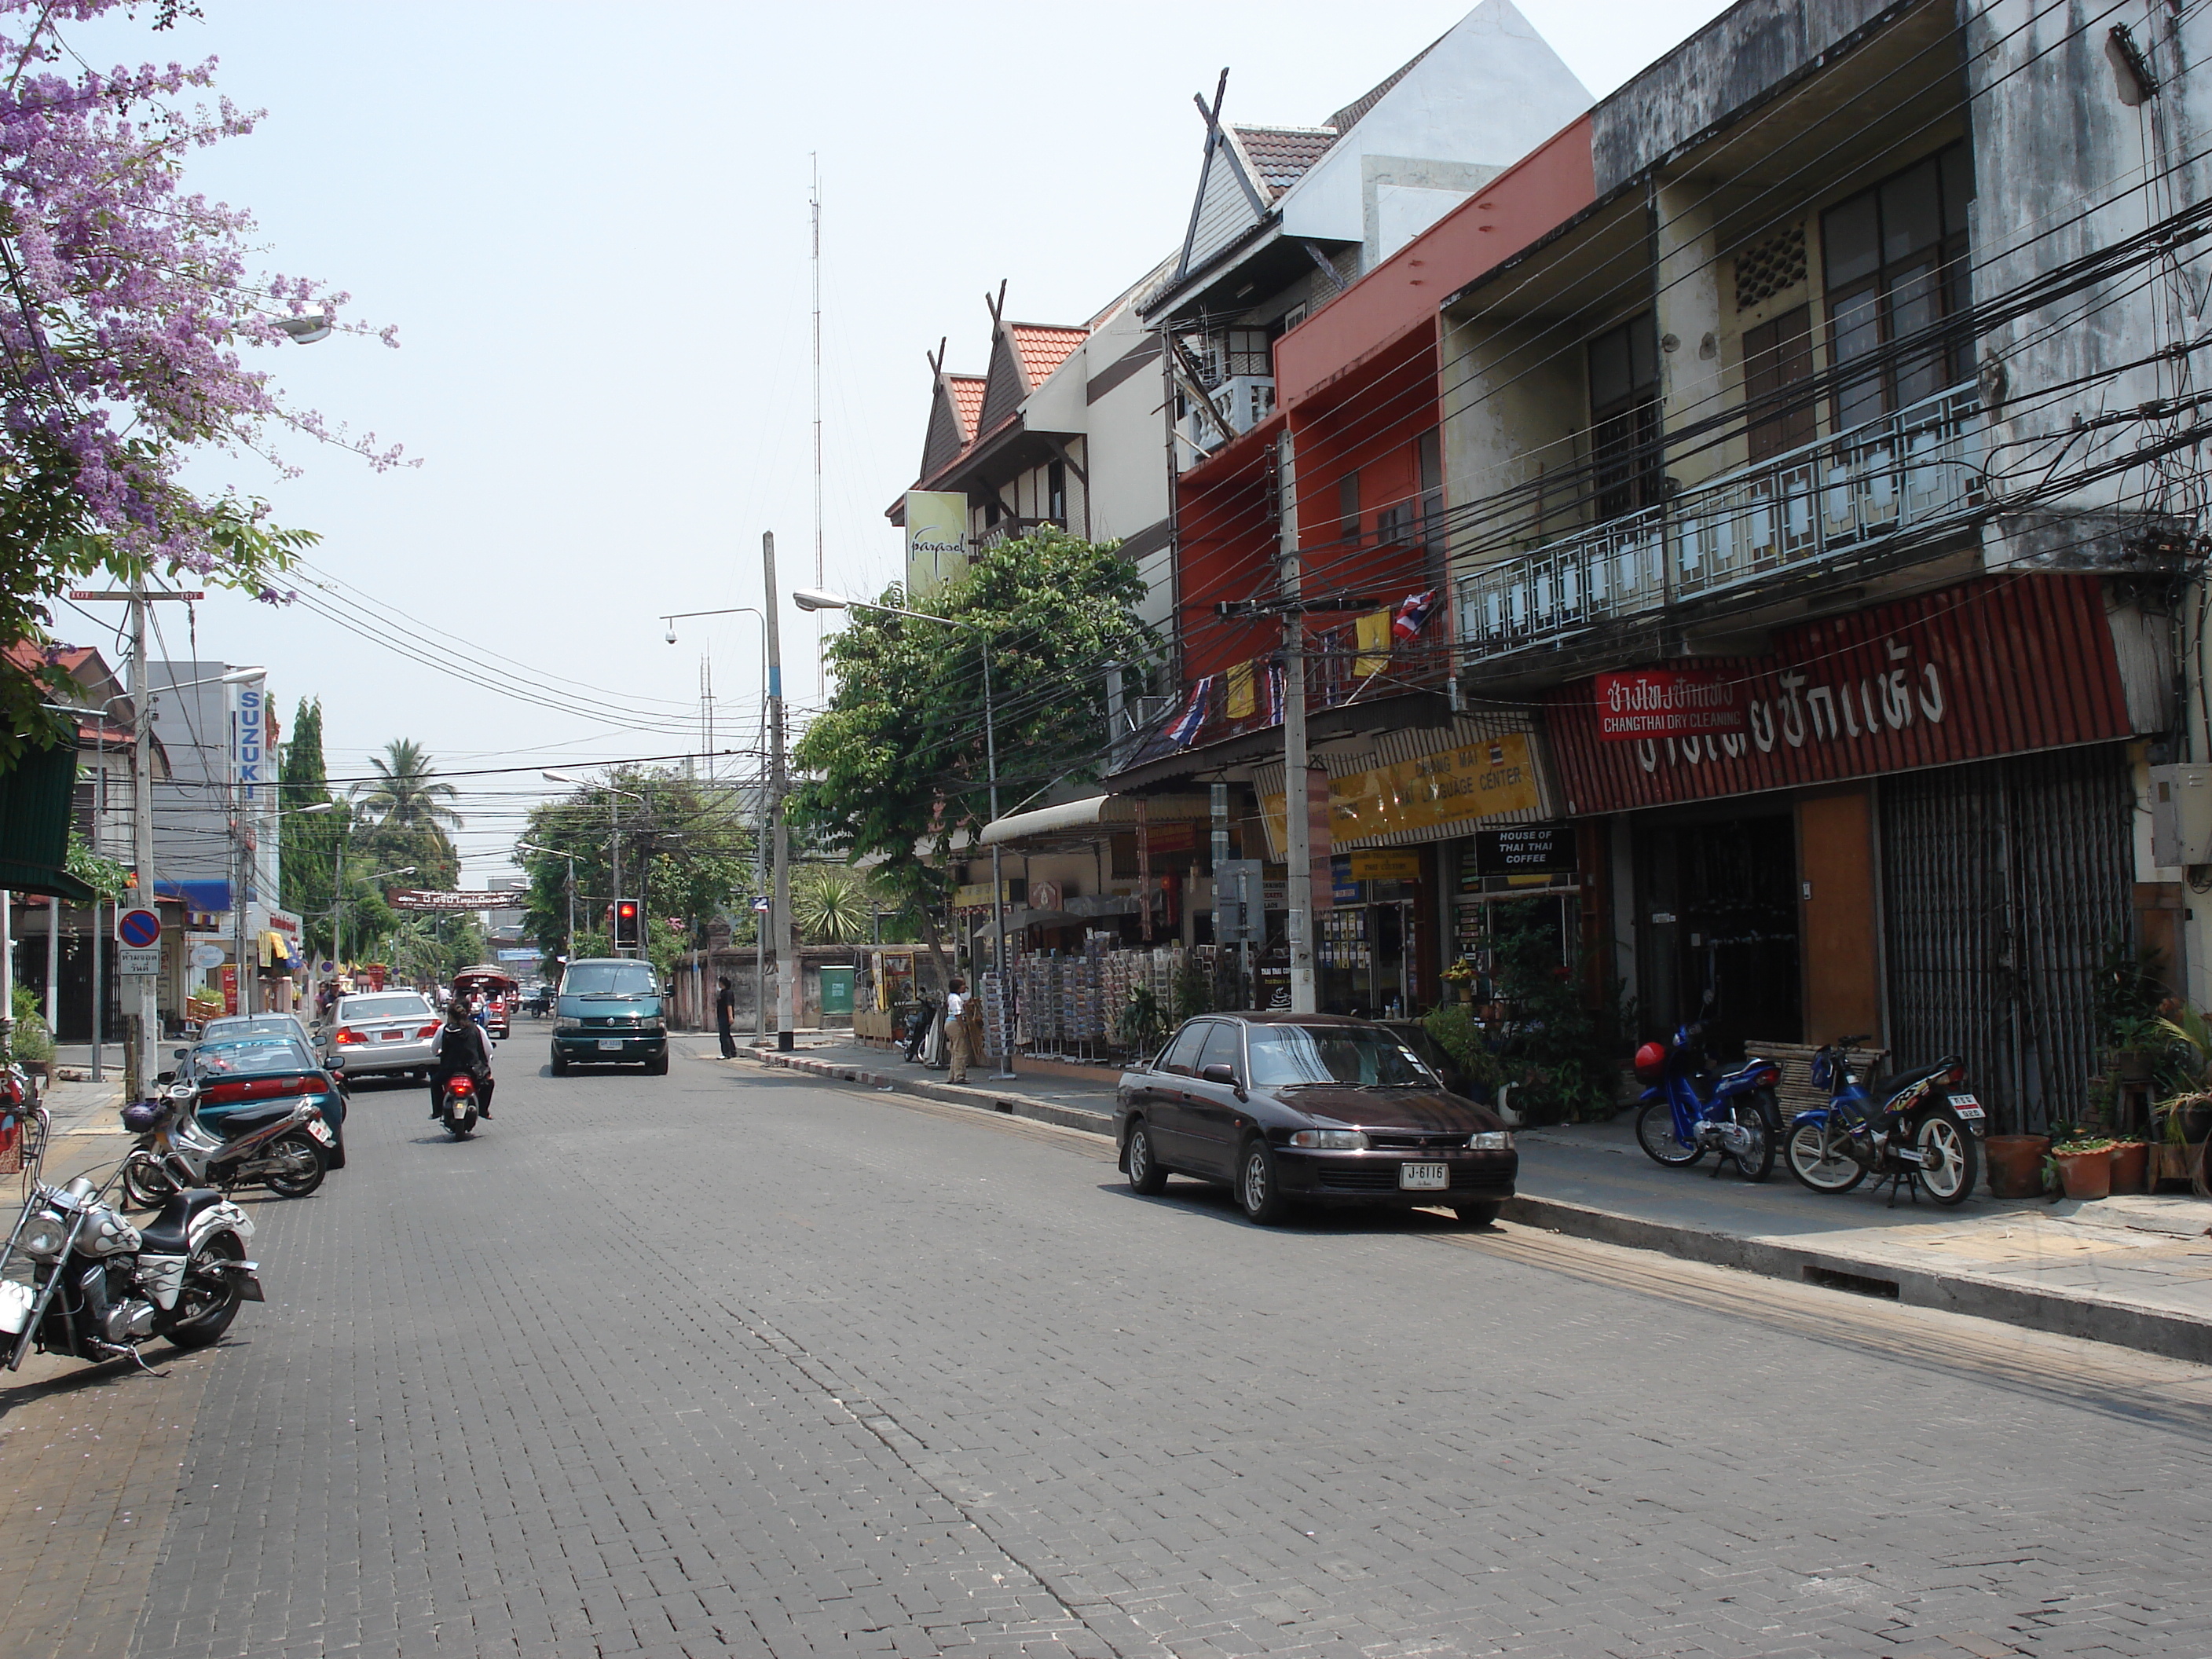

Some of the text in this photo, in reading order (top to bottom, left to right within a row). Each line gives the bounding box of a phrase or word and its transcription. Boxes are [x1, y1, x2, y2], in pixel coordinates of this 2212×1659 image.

[1604, 711, 1741, 733] CHANGTHAI DRY CLEANING
[241, 691, 260, 800] SUZUKI
[1459, 749, 1478, 768] MAI
[1479, 766, 1522, 790] CENTER
[1500, 830, 1553, 841] HOUSE OF
[1499, 842, 1553, 852] THAI THAI
[1506, 854, 1547, 864] COFFEE
[122, 951, 157, 961] ห้ามจอด
[1408, 1166, 1443, 1179] J-6116
